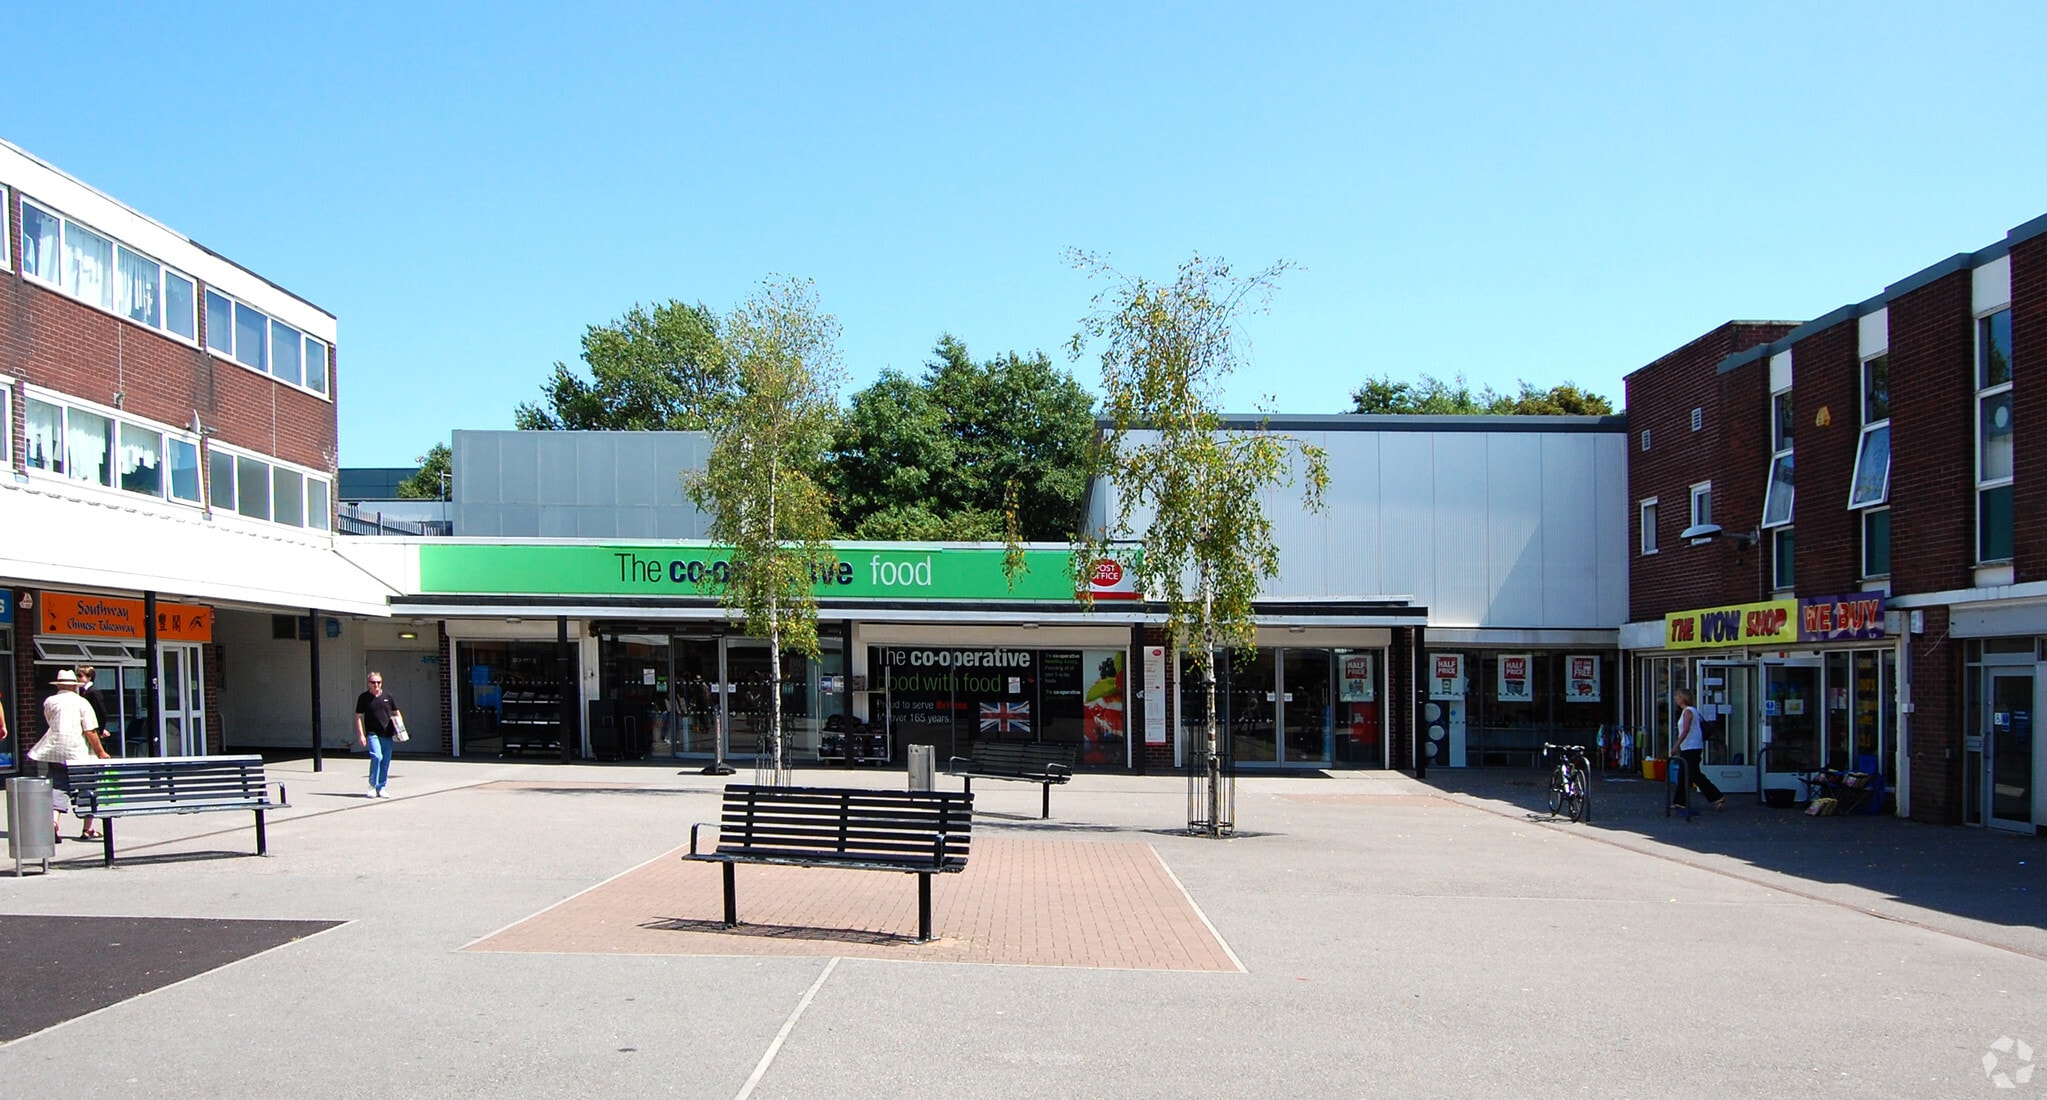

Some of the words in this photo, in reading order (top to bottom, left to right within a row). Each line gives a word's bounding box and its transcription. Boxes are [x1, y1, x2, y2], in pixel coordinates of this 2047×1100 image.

[614, 552, 662, 583] The
[669, 560, 854, 586] co-oive
[869, 554, 932, 586] food
[1095, 564, 1115, 572] POST
[77, 600, 129, 621] Southway
[1802, 603, 1832, 633] WE
[1837, 599, 1879, 631] BUY
[66, 617, 97, 631] Chinese
[98, 619, 136, 637] Takeaway
[1671, 617, 1695, 642] THE
[1700, 610, 1741, 643] WOW
[1746, 608, 1787, 637] SHOP
[876, 647, 906, 665] The
[910, 649, 1031, 670] co-operative
[1437, 660, 1456, 668] HALF
[1505, 661, 1525, 669] HALF
[1437, 667, 1456, 675] PRICE
[923, 672, 959, 692] with
[964, 673, 1001, 692] food
[876, 701, 900, 710] Prud
[902, 702, 910, 710] to
[910, 713, 926, 723] 165
